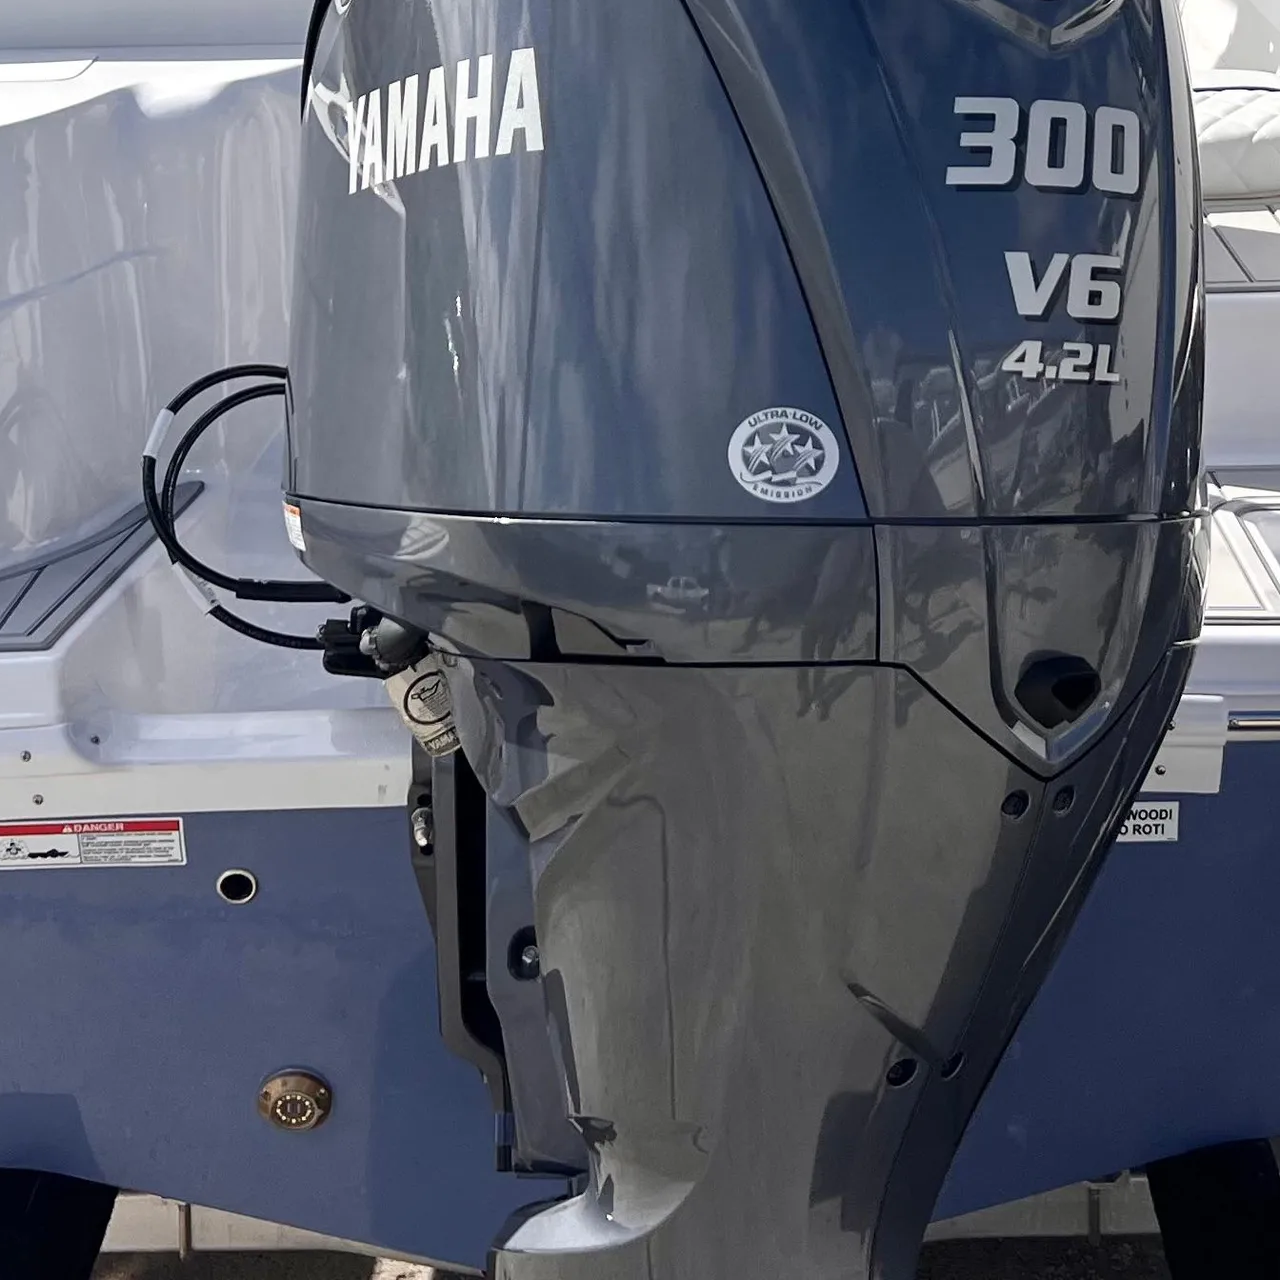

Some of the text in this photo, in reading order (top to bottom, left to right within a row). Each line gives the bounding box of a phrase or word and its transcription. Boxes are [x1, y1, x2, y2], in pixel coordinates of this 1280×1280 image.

[346, 47, 544, 195] YAMAHA
[945, 96, 1140, 195] 300
[1003, 251, 1120, 320] V6
[1001, 340, 1120, 382] 4.2L
[747, 410, 823, 431] ULTRA LOW
[753, 483, 813, 498] EMISSION
[73, 822, 124, 833] DANGER
[1132, 823, 1165, 836] ROTI
